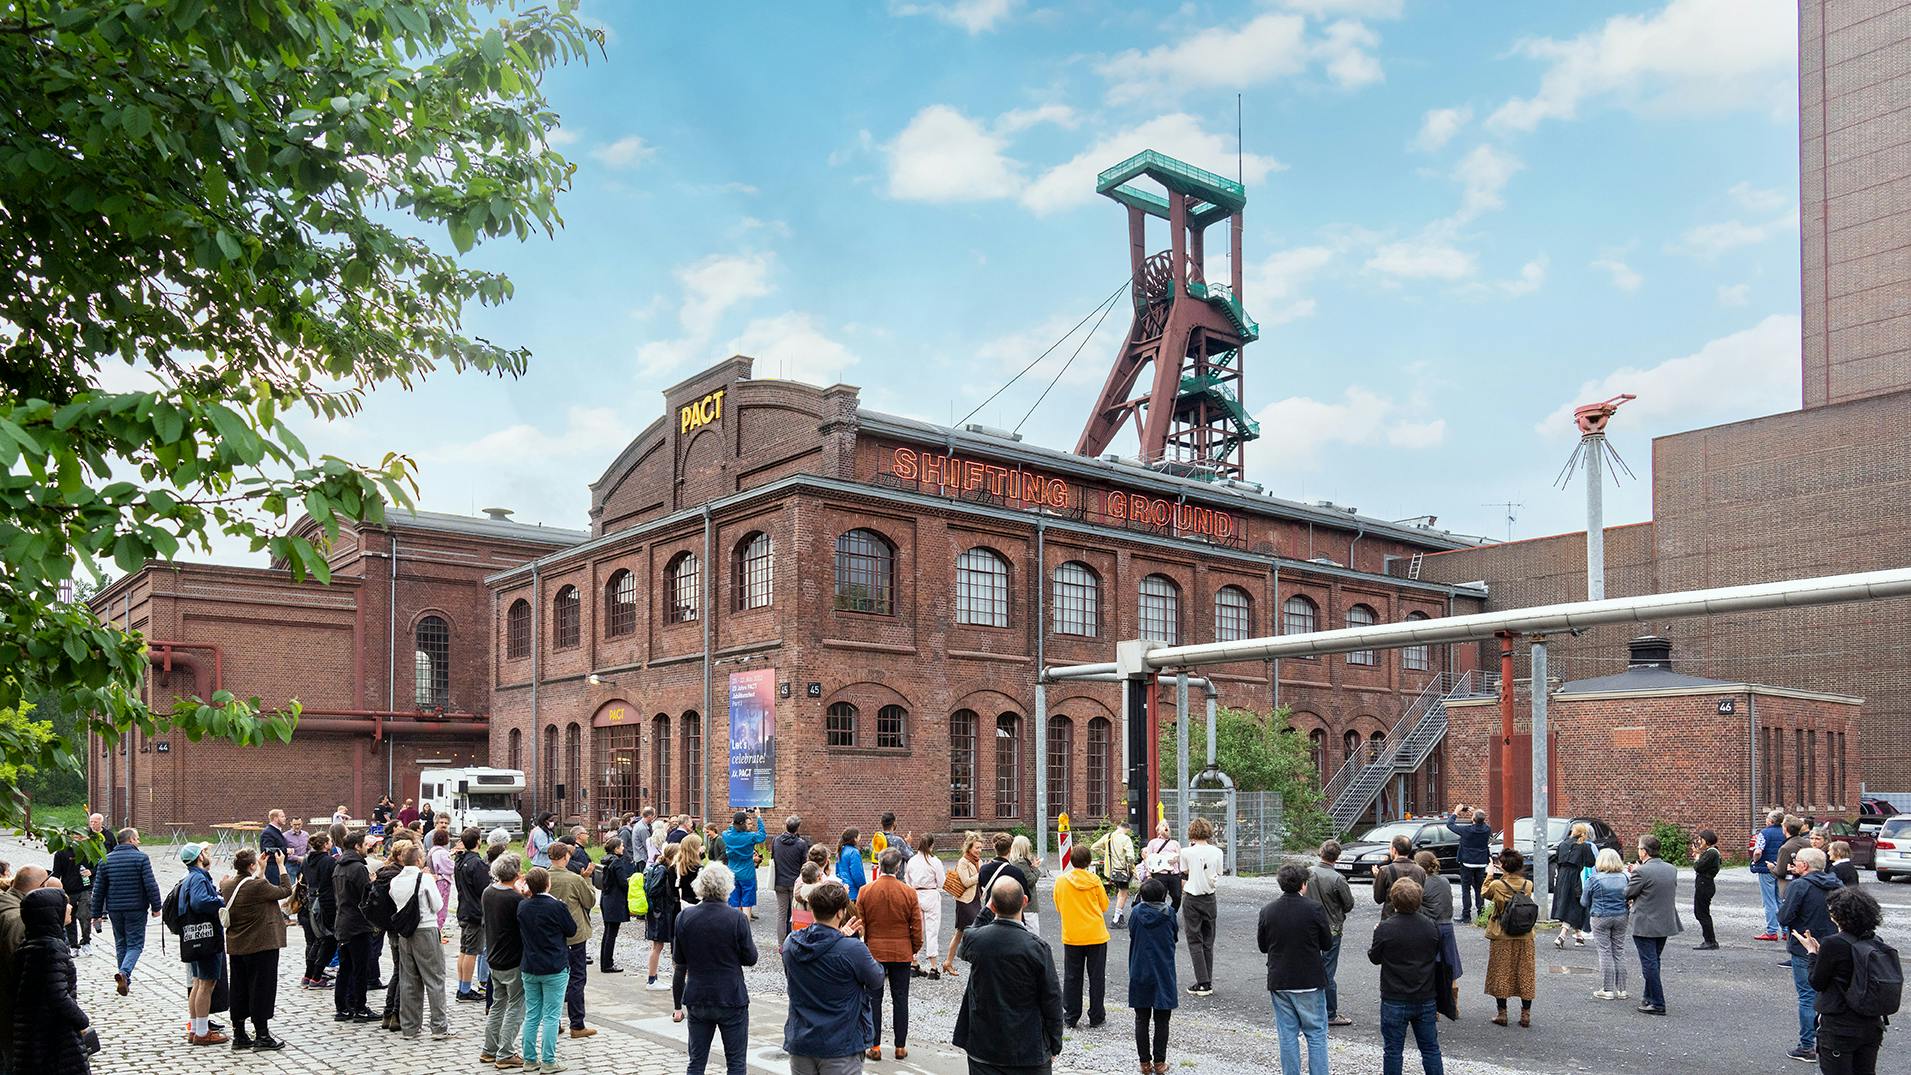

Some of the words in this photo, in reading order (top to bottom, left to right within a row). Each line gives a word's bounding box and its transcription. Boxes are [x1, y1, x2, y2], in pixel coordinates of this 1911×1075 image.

[681, 390, 724, 434] PACT
[892, 447, 1068, 508] SHIFTING
[1107, 490, 1233, 538] GROUND
[781, 685, 788, 694] 45
[810, 685, 820, 694] 45
[1719, 702, 1732, 711] 46
[609, 708, 625, 720] PACT
[731, 752, 766, 764] celebrate!
